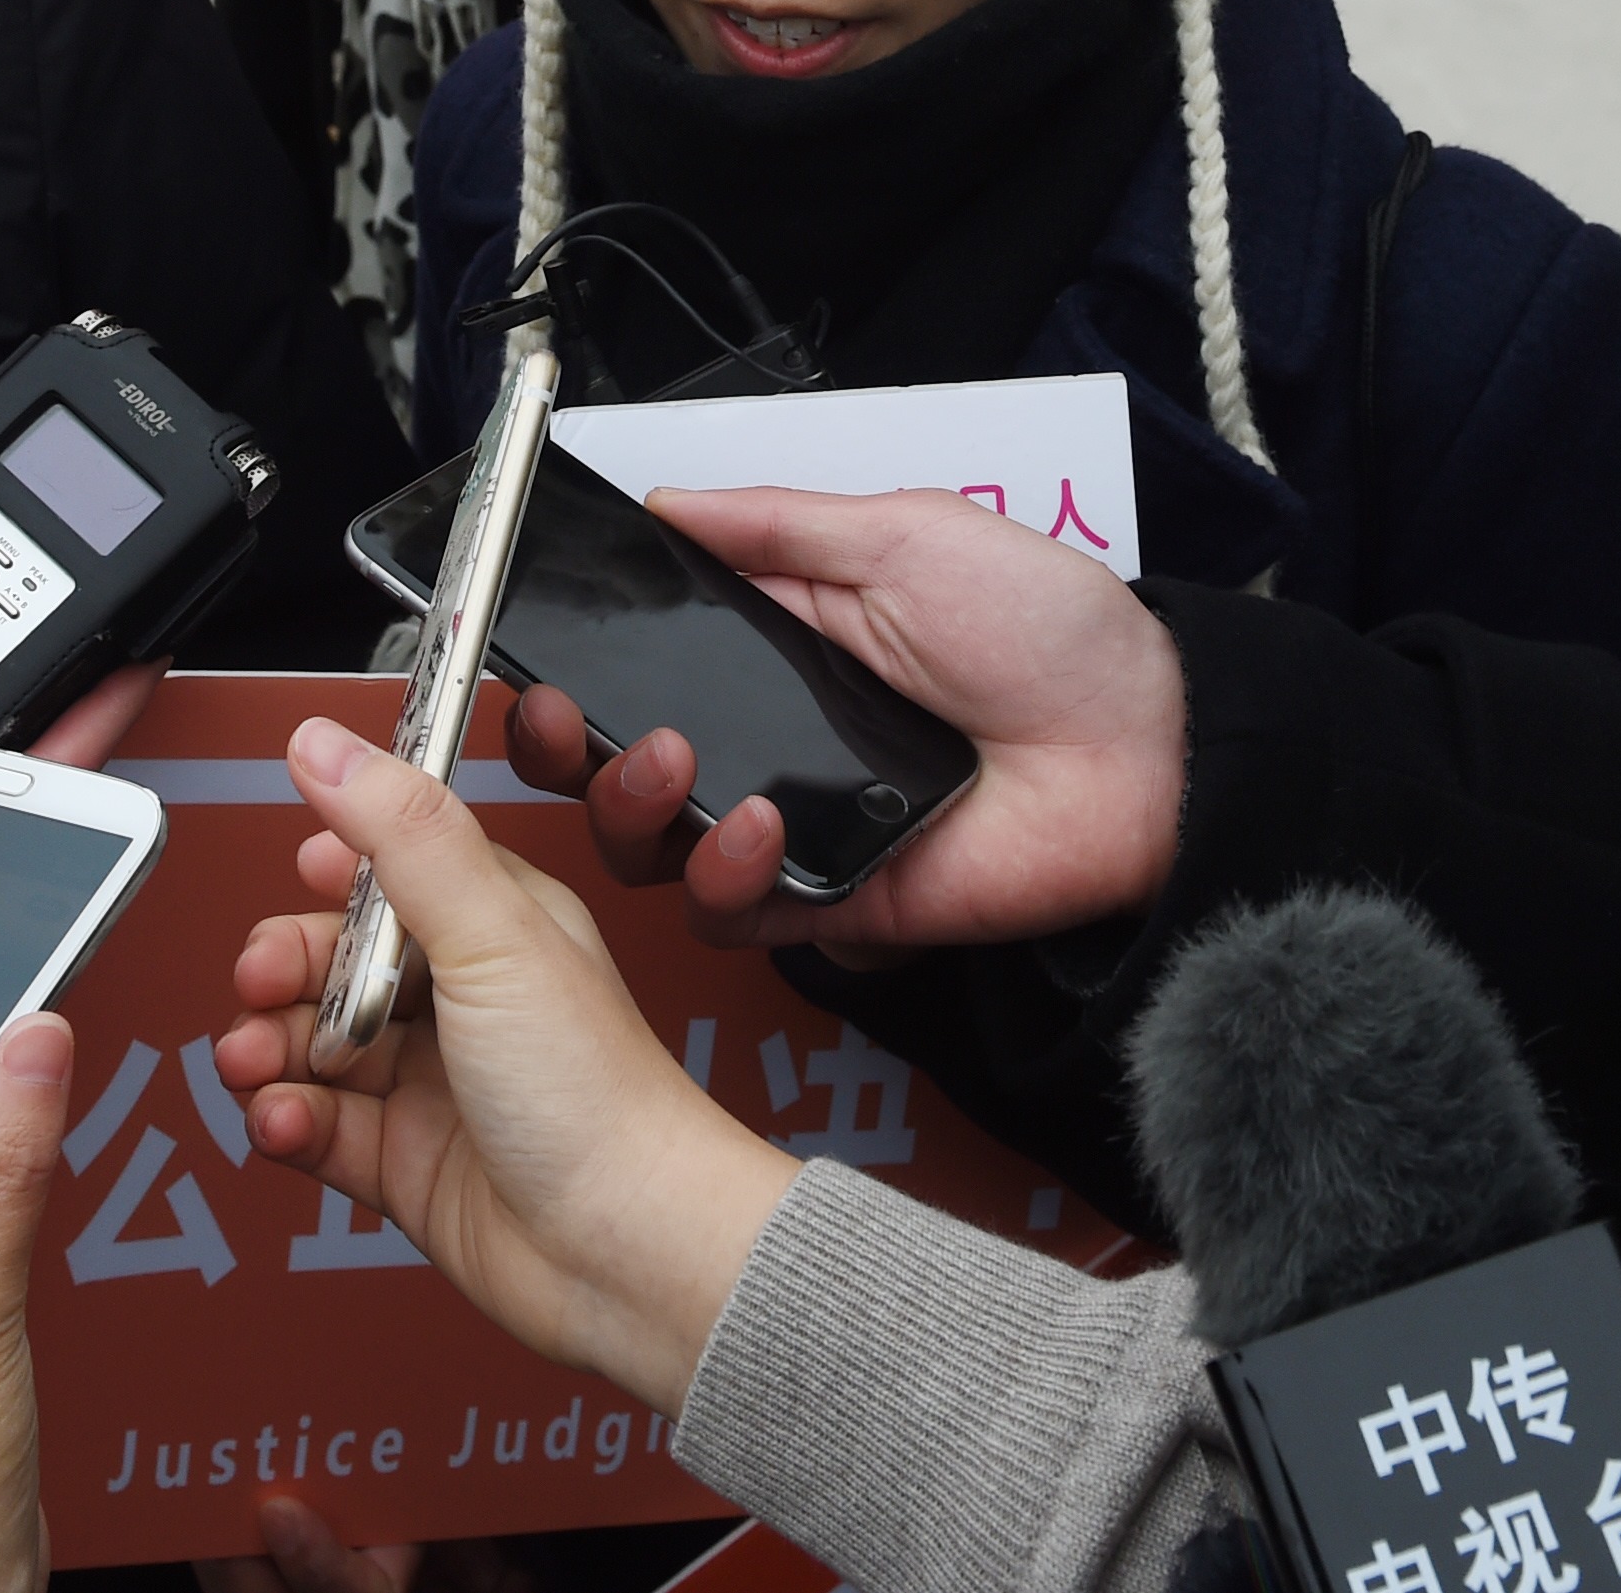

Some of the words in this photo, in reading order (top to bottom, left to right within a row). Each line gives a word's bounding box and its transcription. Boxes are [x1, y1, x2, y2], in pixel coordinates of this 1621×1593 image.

[119, 383, 172, 430] EDIROL
[29, 566, 49, 585] PEAK
[1358, 1344, 1576, 1496] 中传
[107, 1415, 404, 1494] Justice
